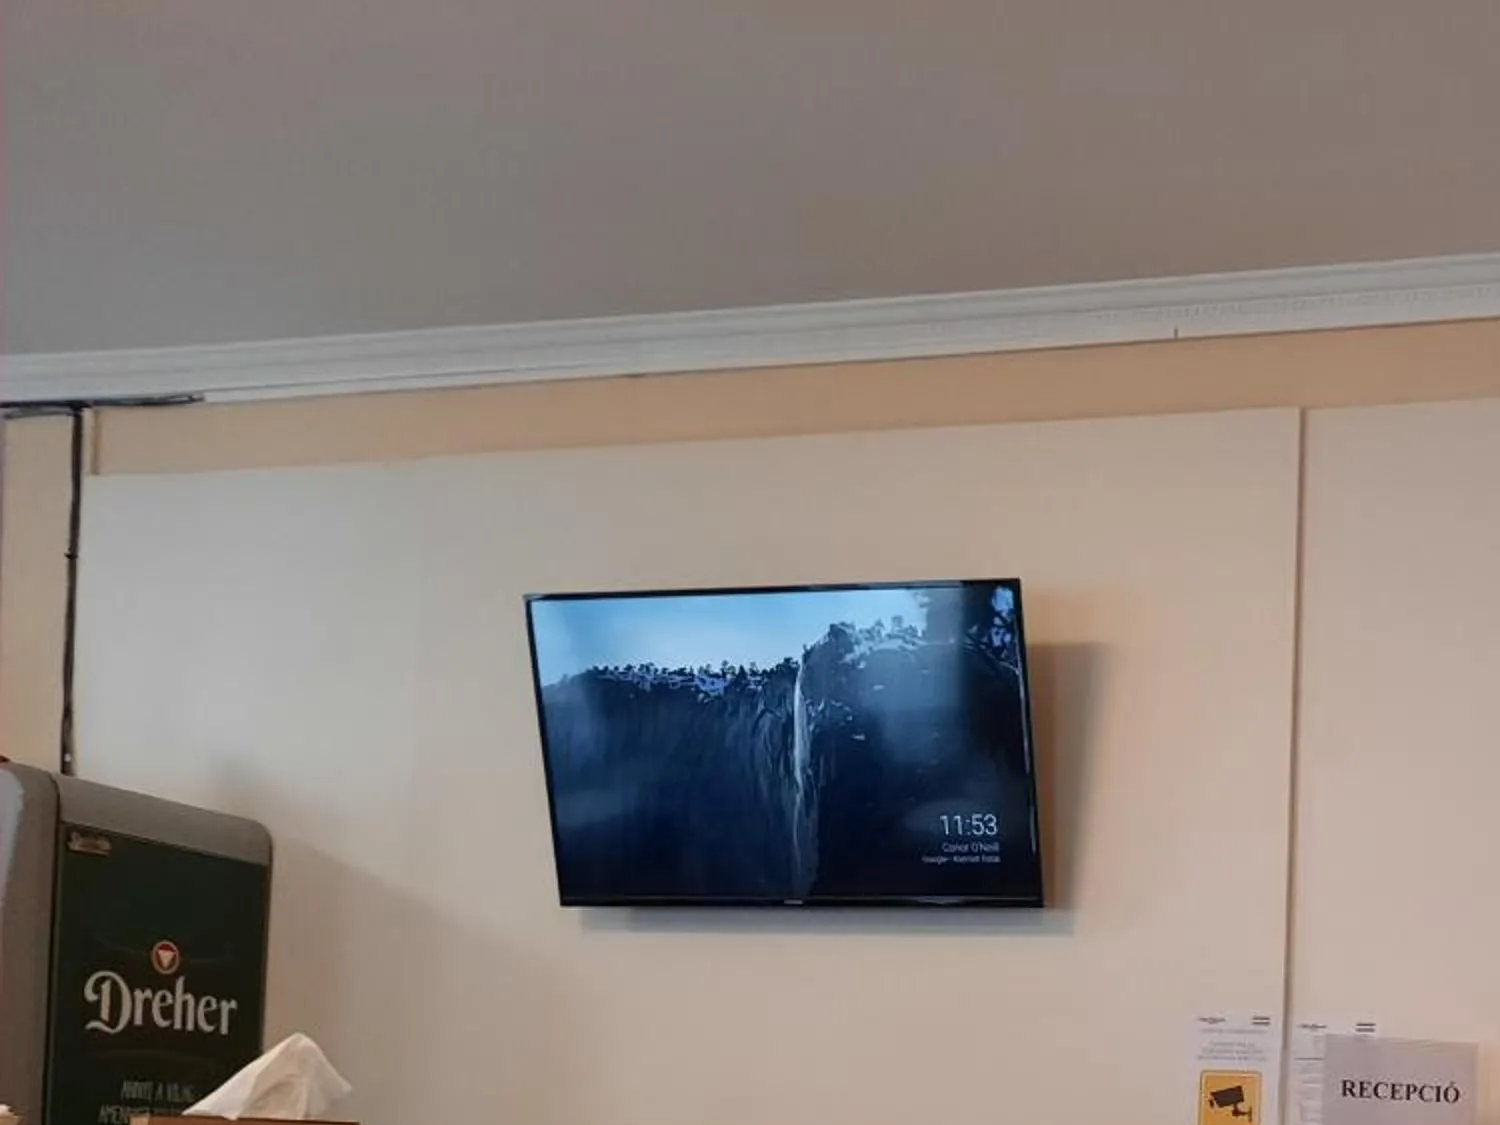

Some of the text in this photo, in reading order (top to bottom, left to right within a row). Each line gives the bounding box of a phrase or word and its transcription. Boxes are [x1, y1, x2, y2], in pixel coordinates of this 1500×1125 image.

[940, 814, 997, 836] 11:53
[83, 969, 238, 1036] Dreher
[1341, 1080, 1461, 1104] RECEPCIÓ
